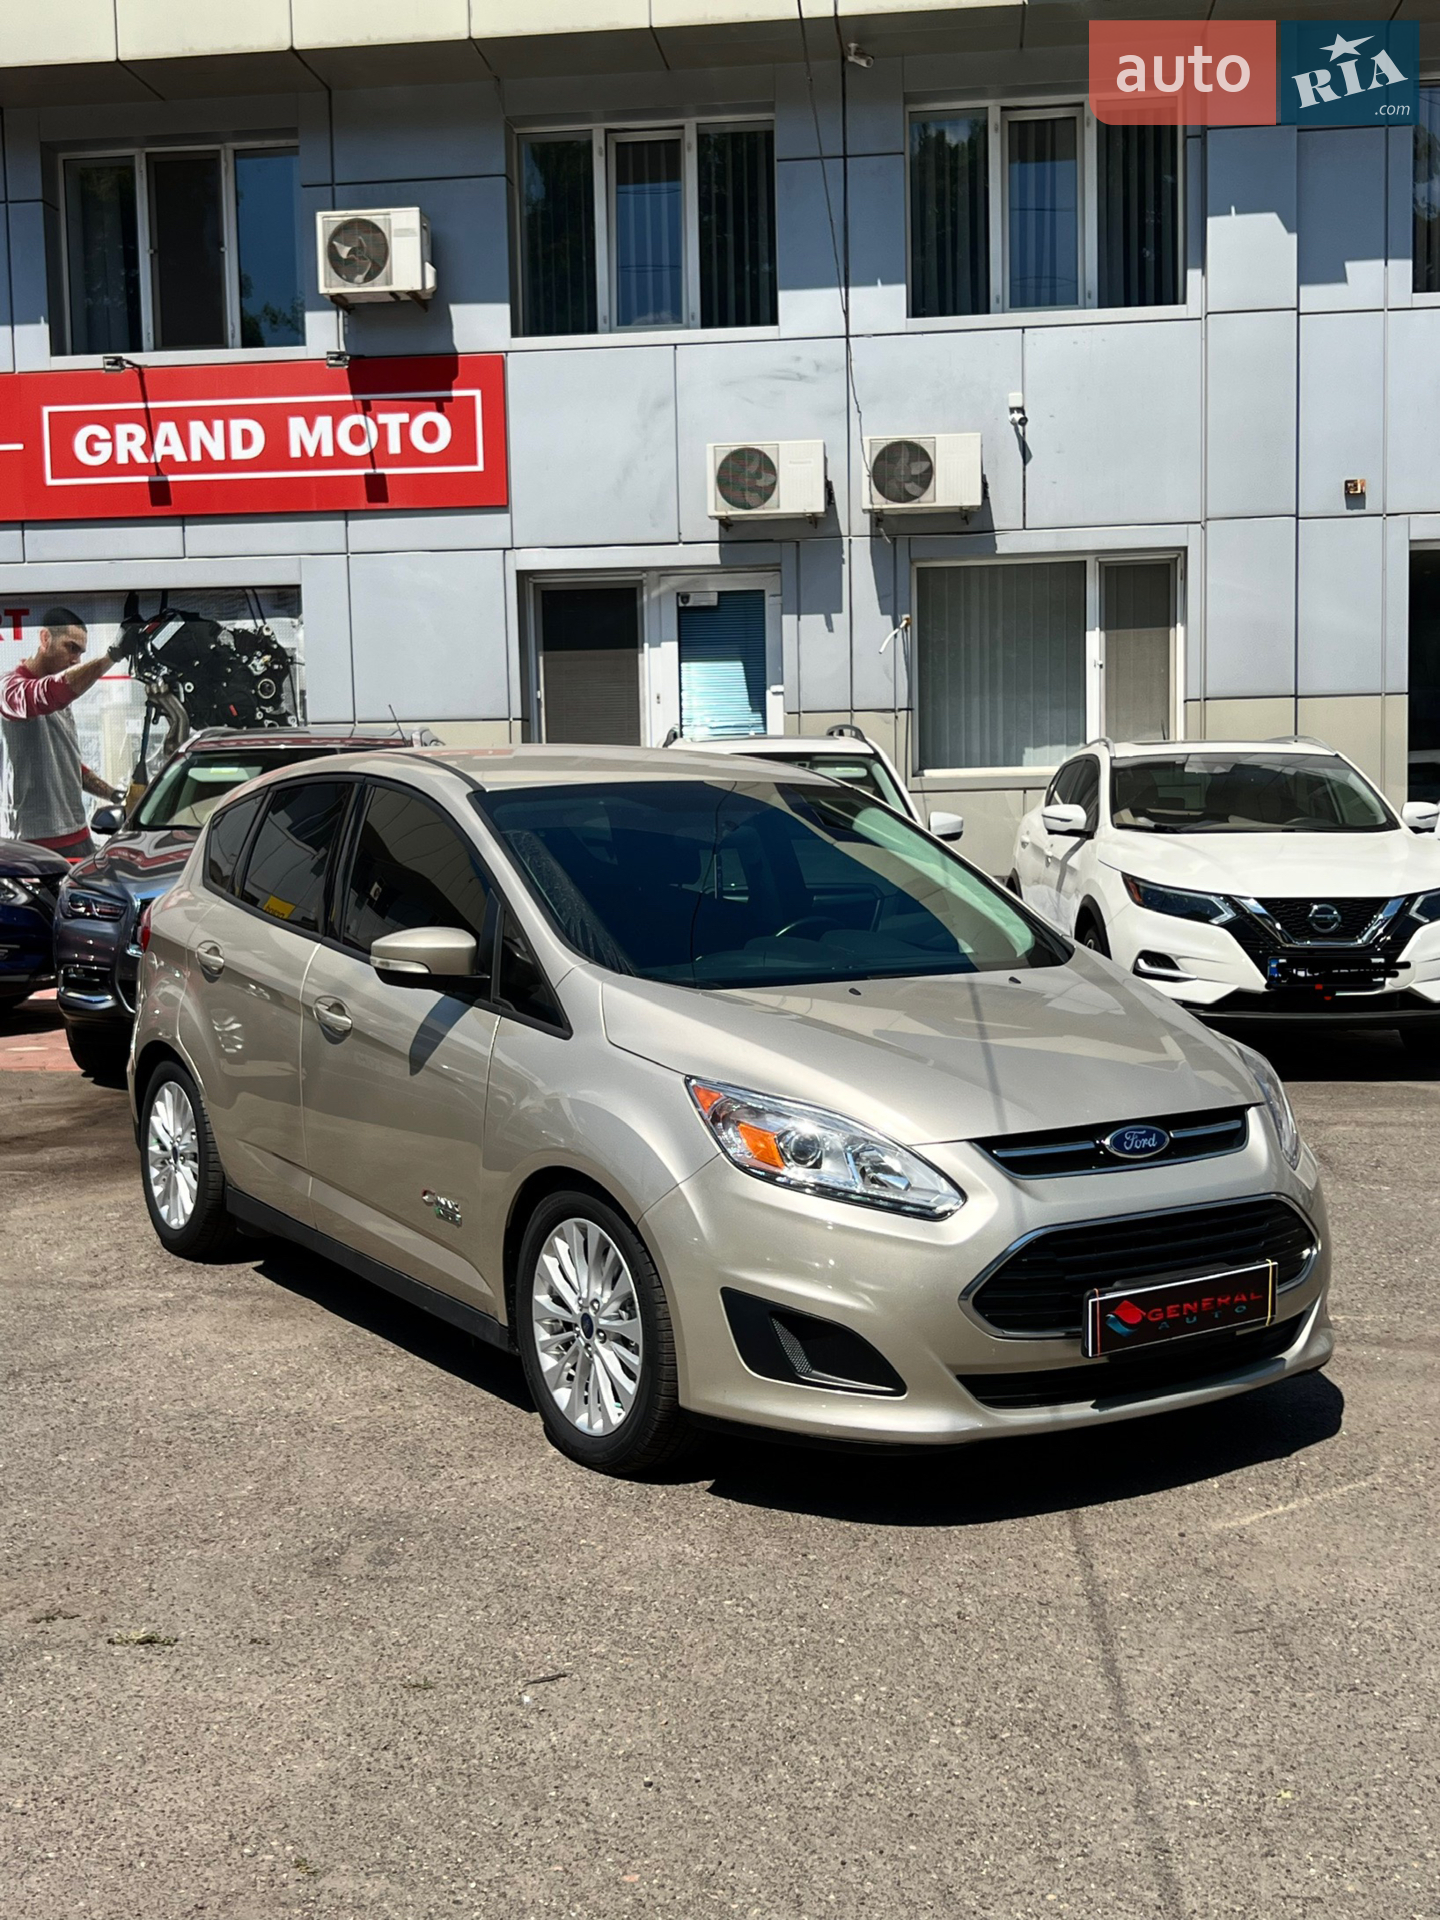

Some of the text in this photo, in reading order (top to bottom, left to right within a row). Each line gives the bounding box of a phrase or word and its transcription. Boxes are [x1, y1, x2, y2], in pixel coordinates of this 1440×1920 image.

[73, 411, 452, 466] GRAND MOTO
[1123, 1130, 1158, 1150] Ford
[1147, 1292, 1263, 1322] GENERAL
